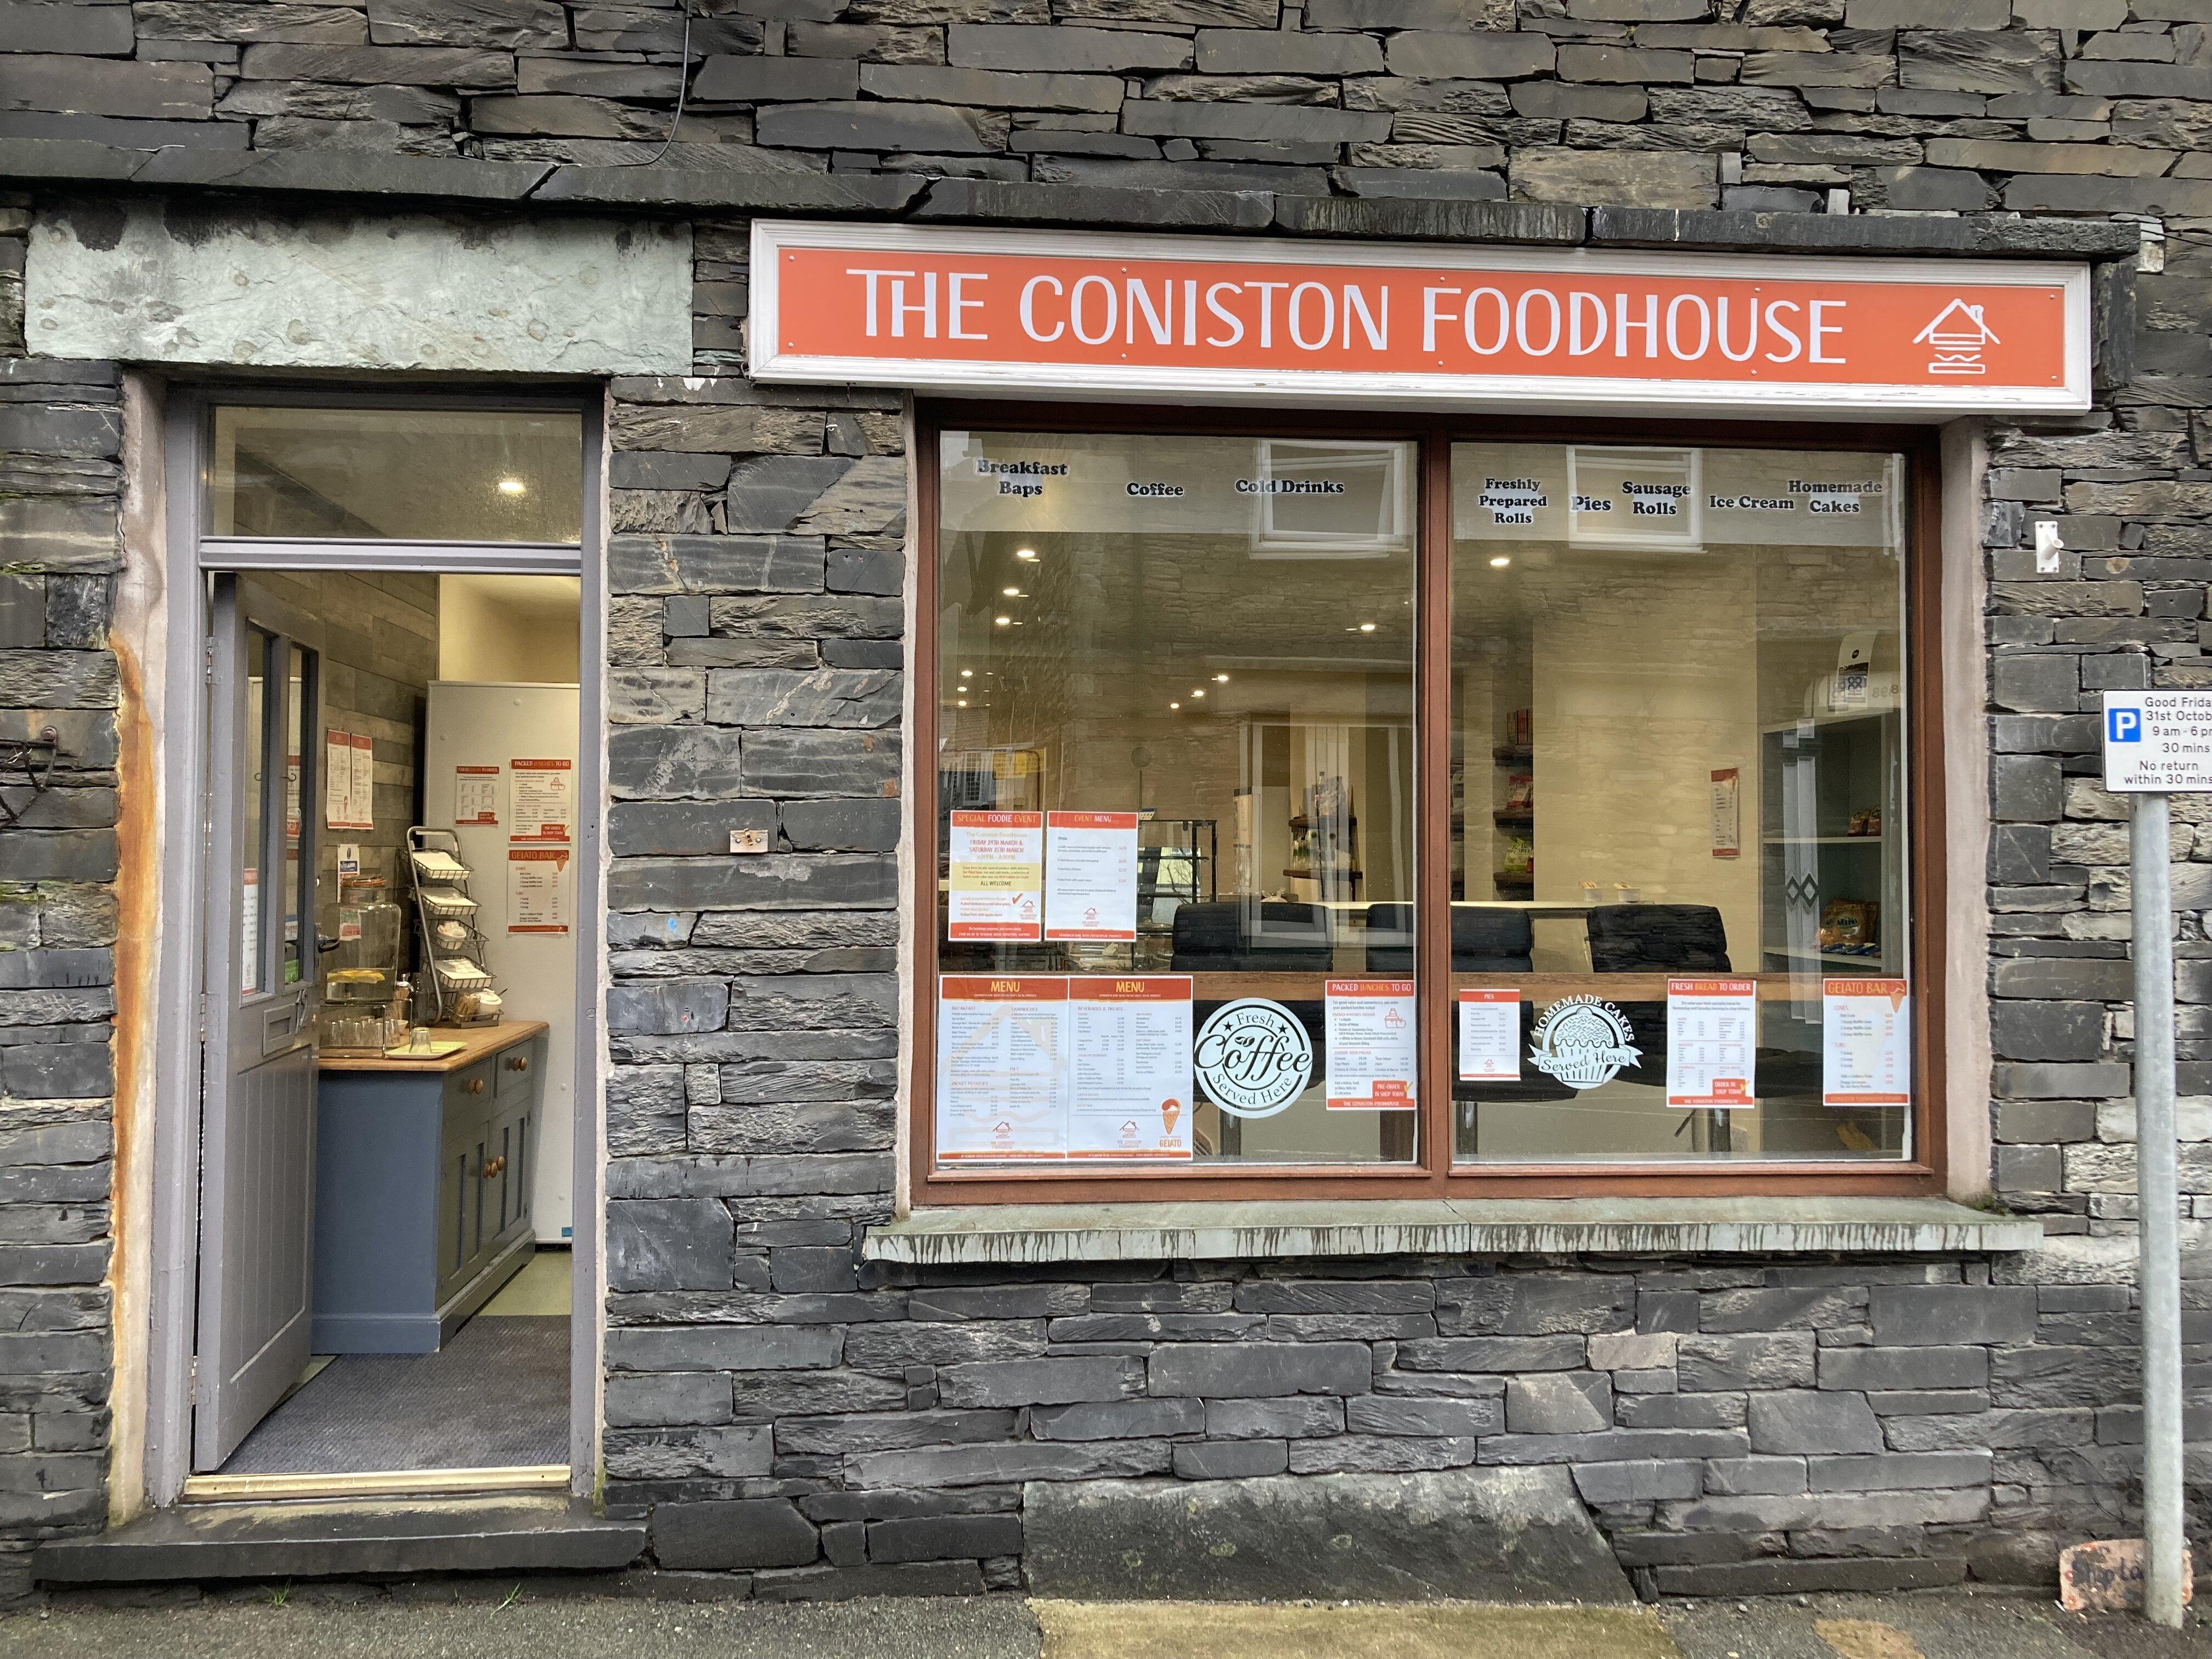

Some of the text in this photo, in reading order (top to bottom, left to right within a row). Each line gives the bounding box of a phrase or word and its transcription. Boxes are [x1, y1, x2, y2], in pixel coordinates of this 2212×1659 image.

[847, 269, 1847, 364] THE CONISTON FOODHOUSE
[977, 460, 1068, 475] Breakfast
[1000, 482, 1042, 497] Baps
[1126, 483, 1183, 496] Coffee
[1235, 479, 1344, 494] Cold Drinks
[1486, 478, 1541, 492] Freshly
[1622, 482, 1691, 496] Sausage
[1788, 481, 1882, 493] Homemade
[1479, 495, 1547, 509] Prepared
[1572, 496, 1611, 511] Pies
[1633, 501, 1677, 515] Rolls
[1709, 495, 1794, 510] Ice Cream
[1810, 500, 1859, 513] Cakes
[1494, 512, 1532, 524] Rolls
[2145, 697, 2212, 707] Good Frida
[2146, 711, 2171, 720] 31st
[2116, 712, 2136, 739] P
[2163, 743, 2210, 753] 30 mins
[2140, 761, 2198, 770] No return
[2124, 774, 2212, 783] within 30 mins
[991, 981, 1020, 992] MENU
[1116, 981, 1145, 992] MENU
[1332, 983, 1411, 991] PACKED LUNCHES TO GO
[1671, 983, 1751, 991] FRESH BREAD TO ORDER
[1828, 983, 1887, 994] GELATO BAR
[1235, 1012, 1274, 1028] Fresh
[1533, 994, 1602, 1038] HOMEMADE
[1605, 1002, 1635, 1041] CAKES
[1194, 1034, 1312, 1081] Coffee
[1541, 1050, 1625, 1071] Served Here
[1213, 1073, 1292, 1104] Served Here
